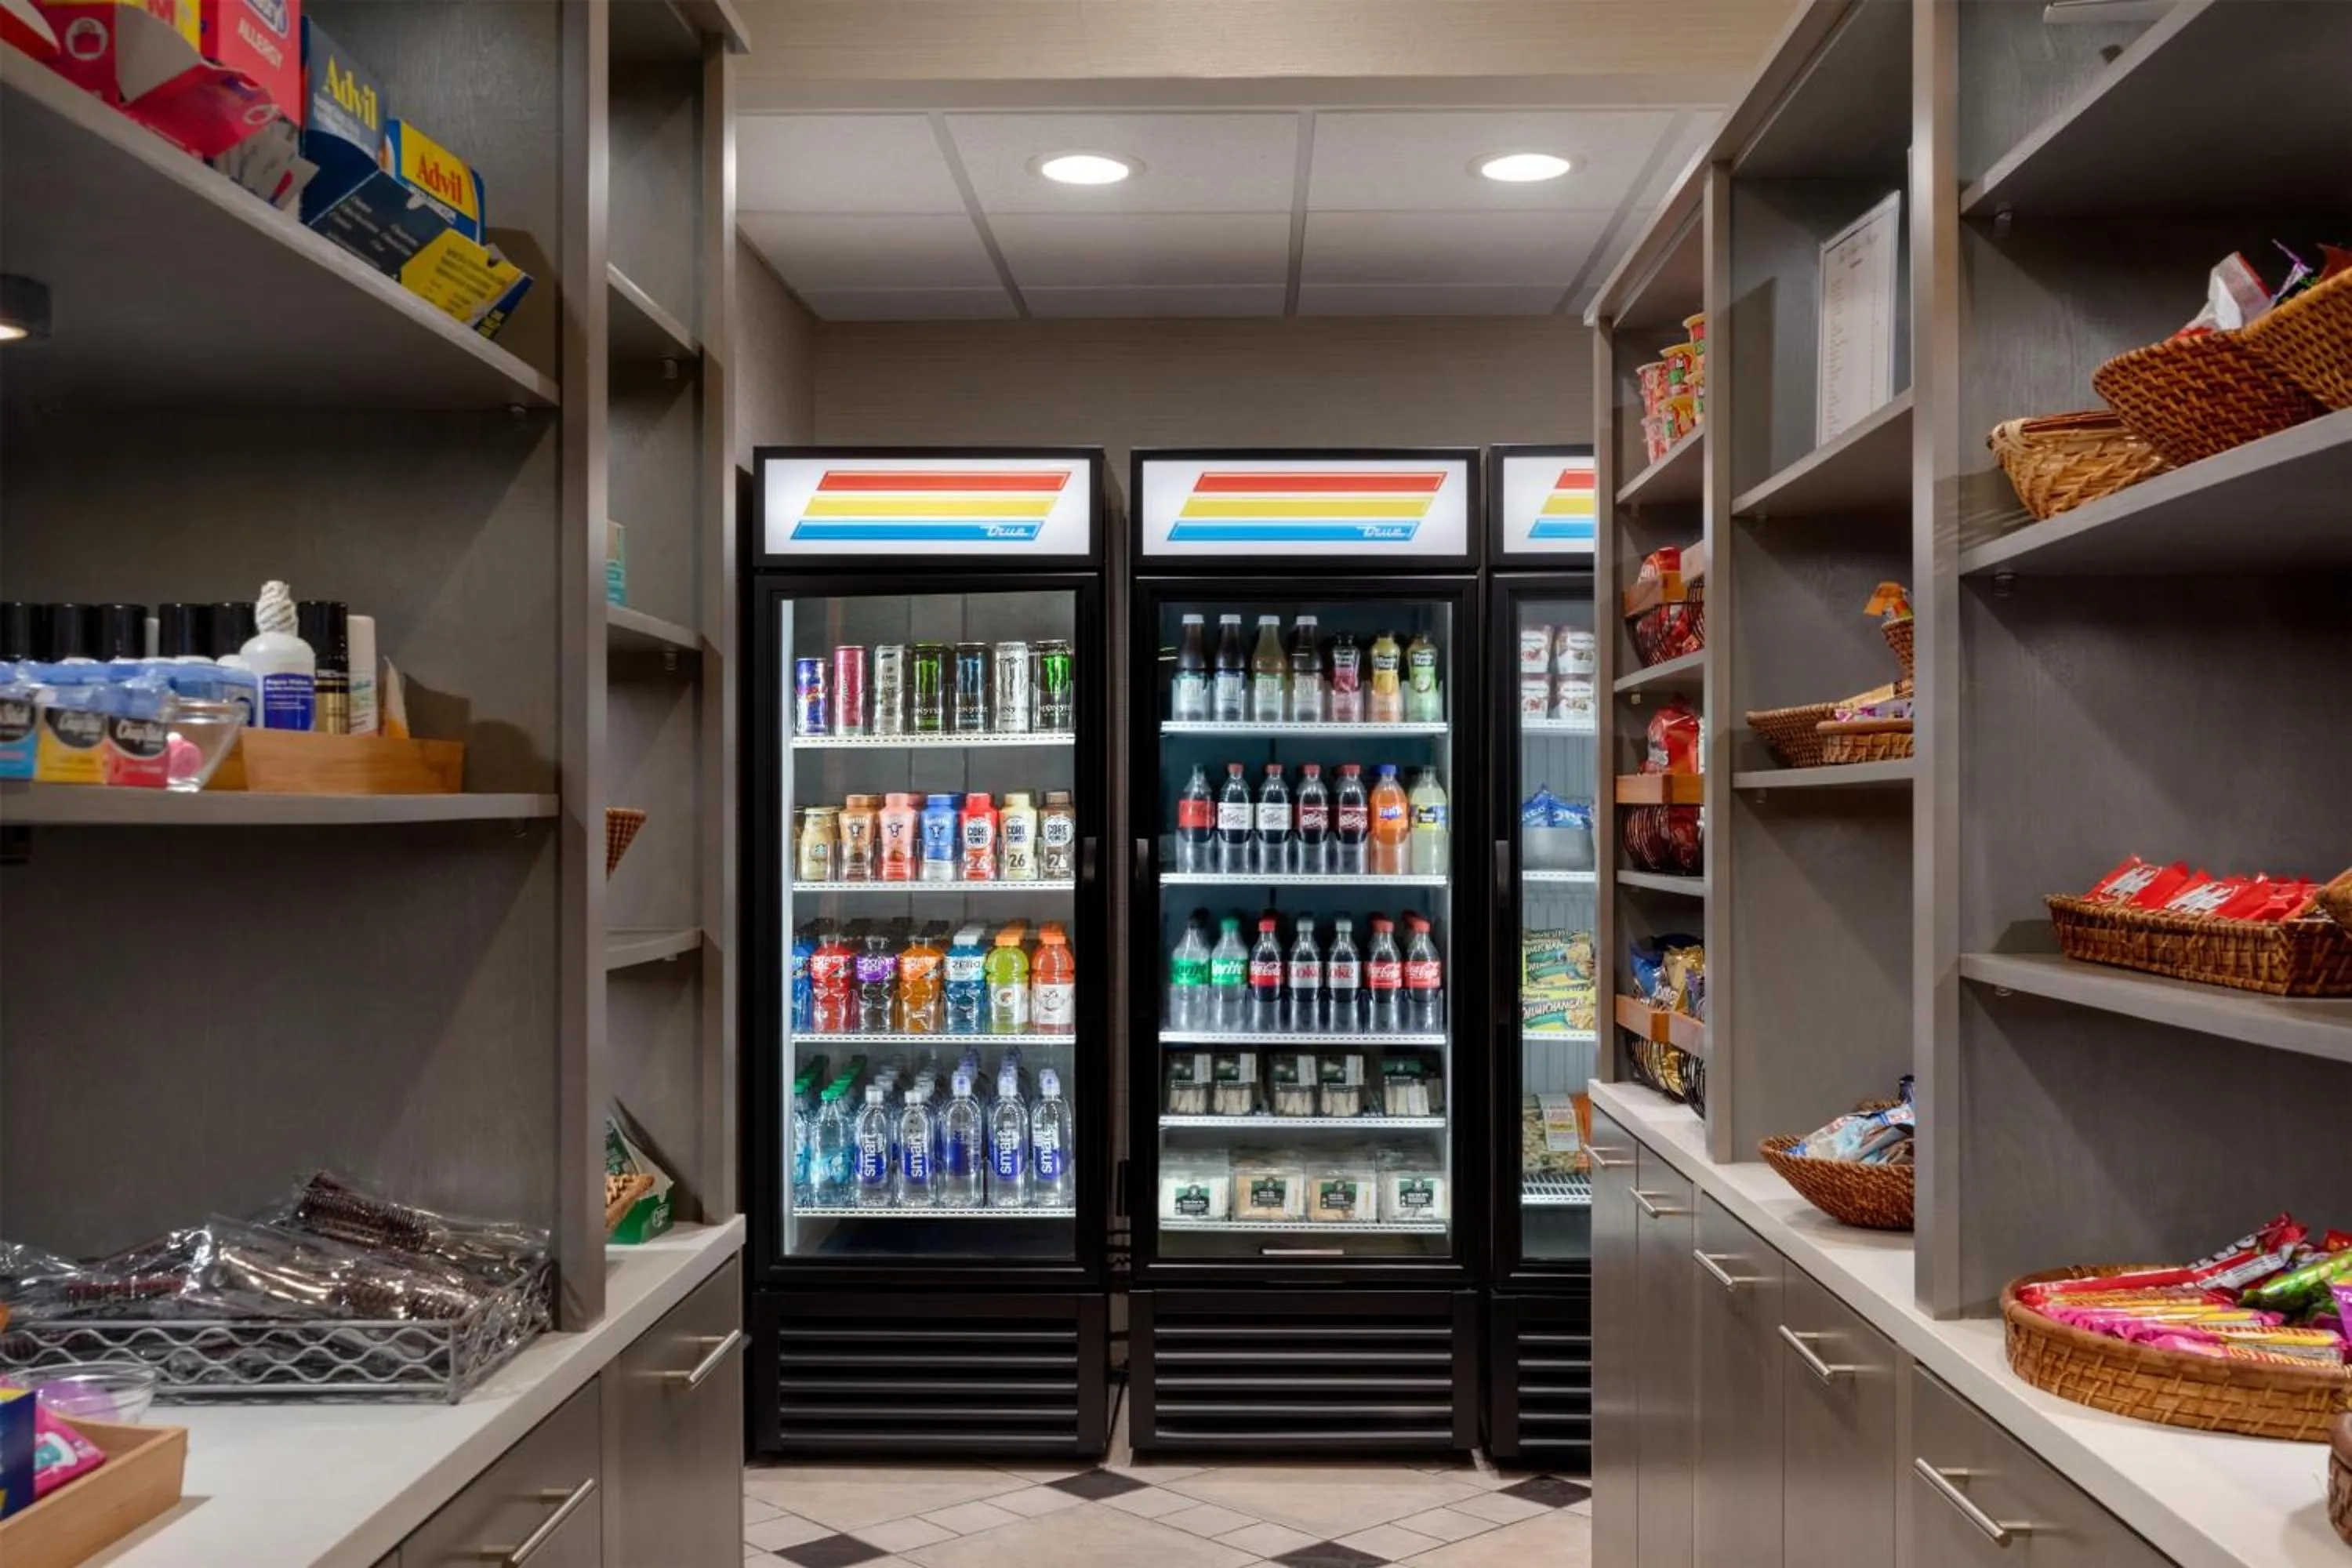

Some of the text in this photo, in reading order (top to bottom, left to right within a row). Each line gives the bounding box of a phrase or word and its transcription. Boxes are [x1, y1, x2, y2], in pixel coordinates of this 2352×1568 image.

[237, 17, 283, 71] ALLERGY
[322, 53, 377, 131] Advil
[416, 151, 463, 205] Advil
[1009, 854, 1026, 868] 26
[952, 959, 981, 969] ZERO
[861, 1132, 877, 1178] smart
[908, 1136, 924, 1178] smart
[997, 1130, 1012, 1174] smart
[1040, 1125, 1054, 1174] smart
